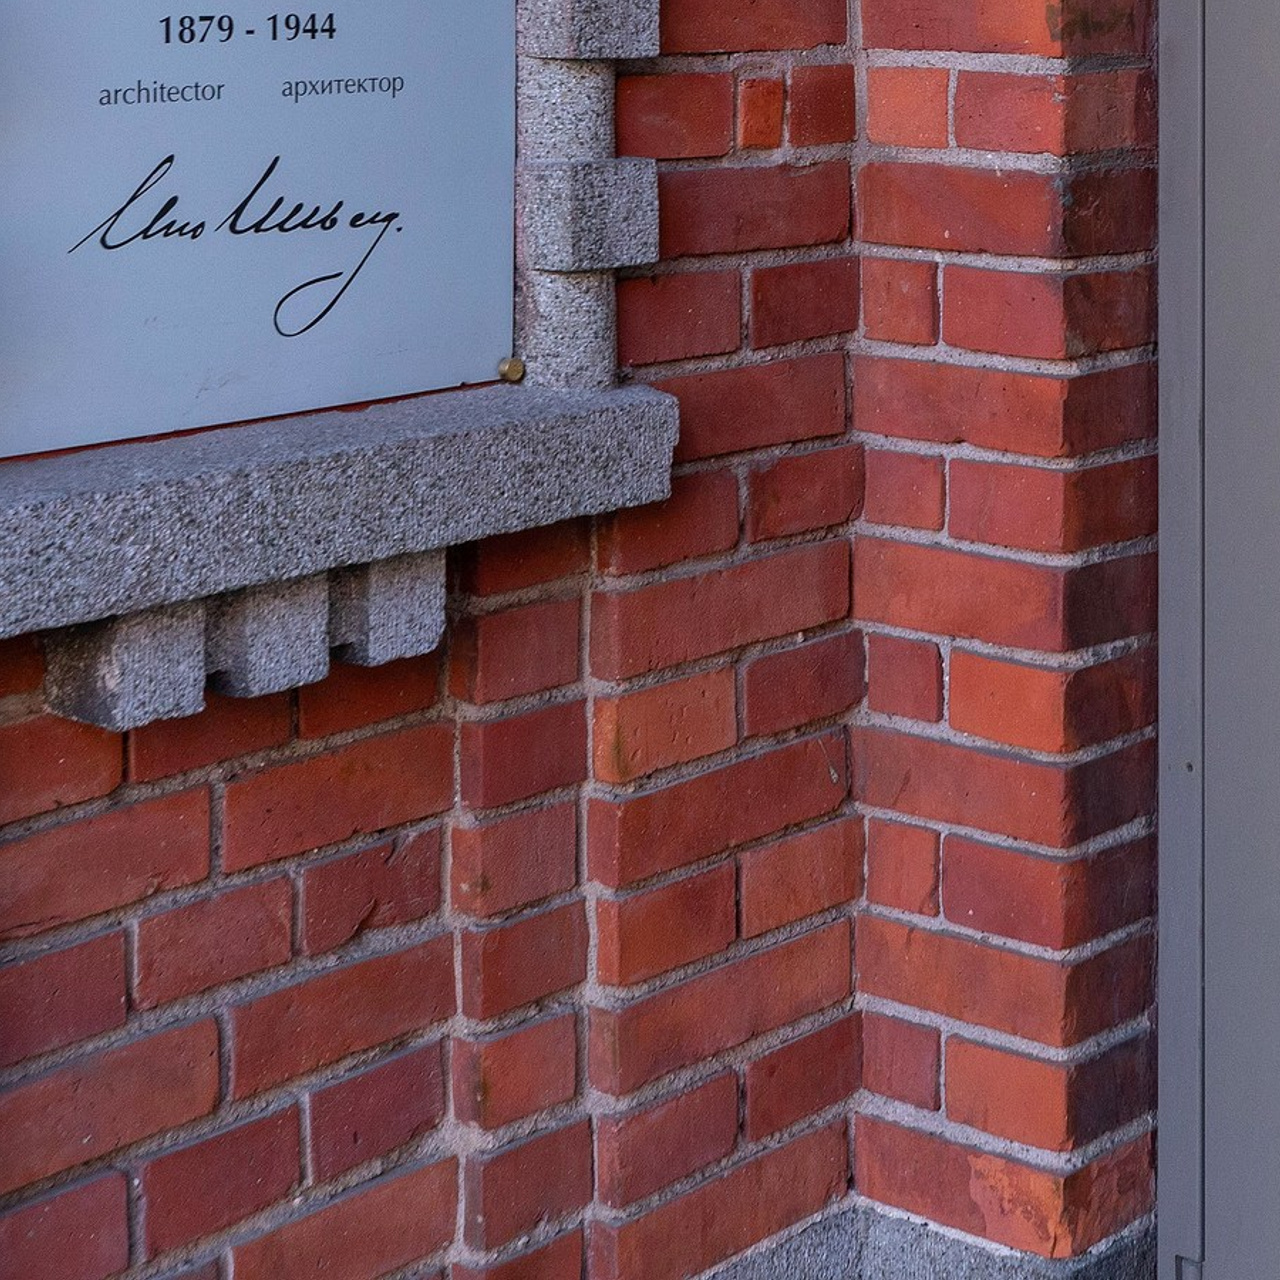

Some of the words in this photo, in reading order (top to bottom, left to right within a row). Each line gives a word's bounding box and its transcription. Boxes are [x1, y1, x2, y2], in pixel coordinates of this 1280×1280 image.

[158, 15, 235, 44] 1879
[266, 12, 337, 41] 1944
[99, 79, 226, 106] architector
[281, 75, 405, 104] архитектор
